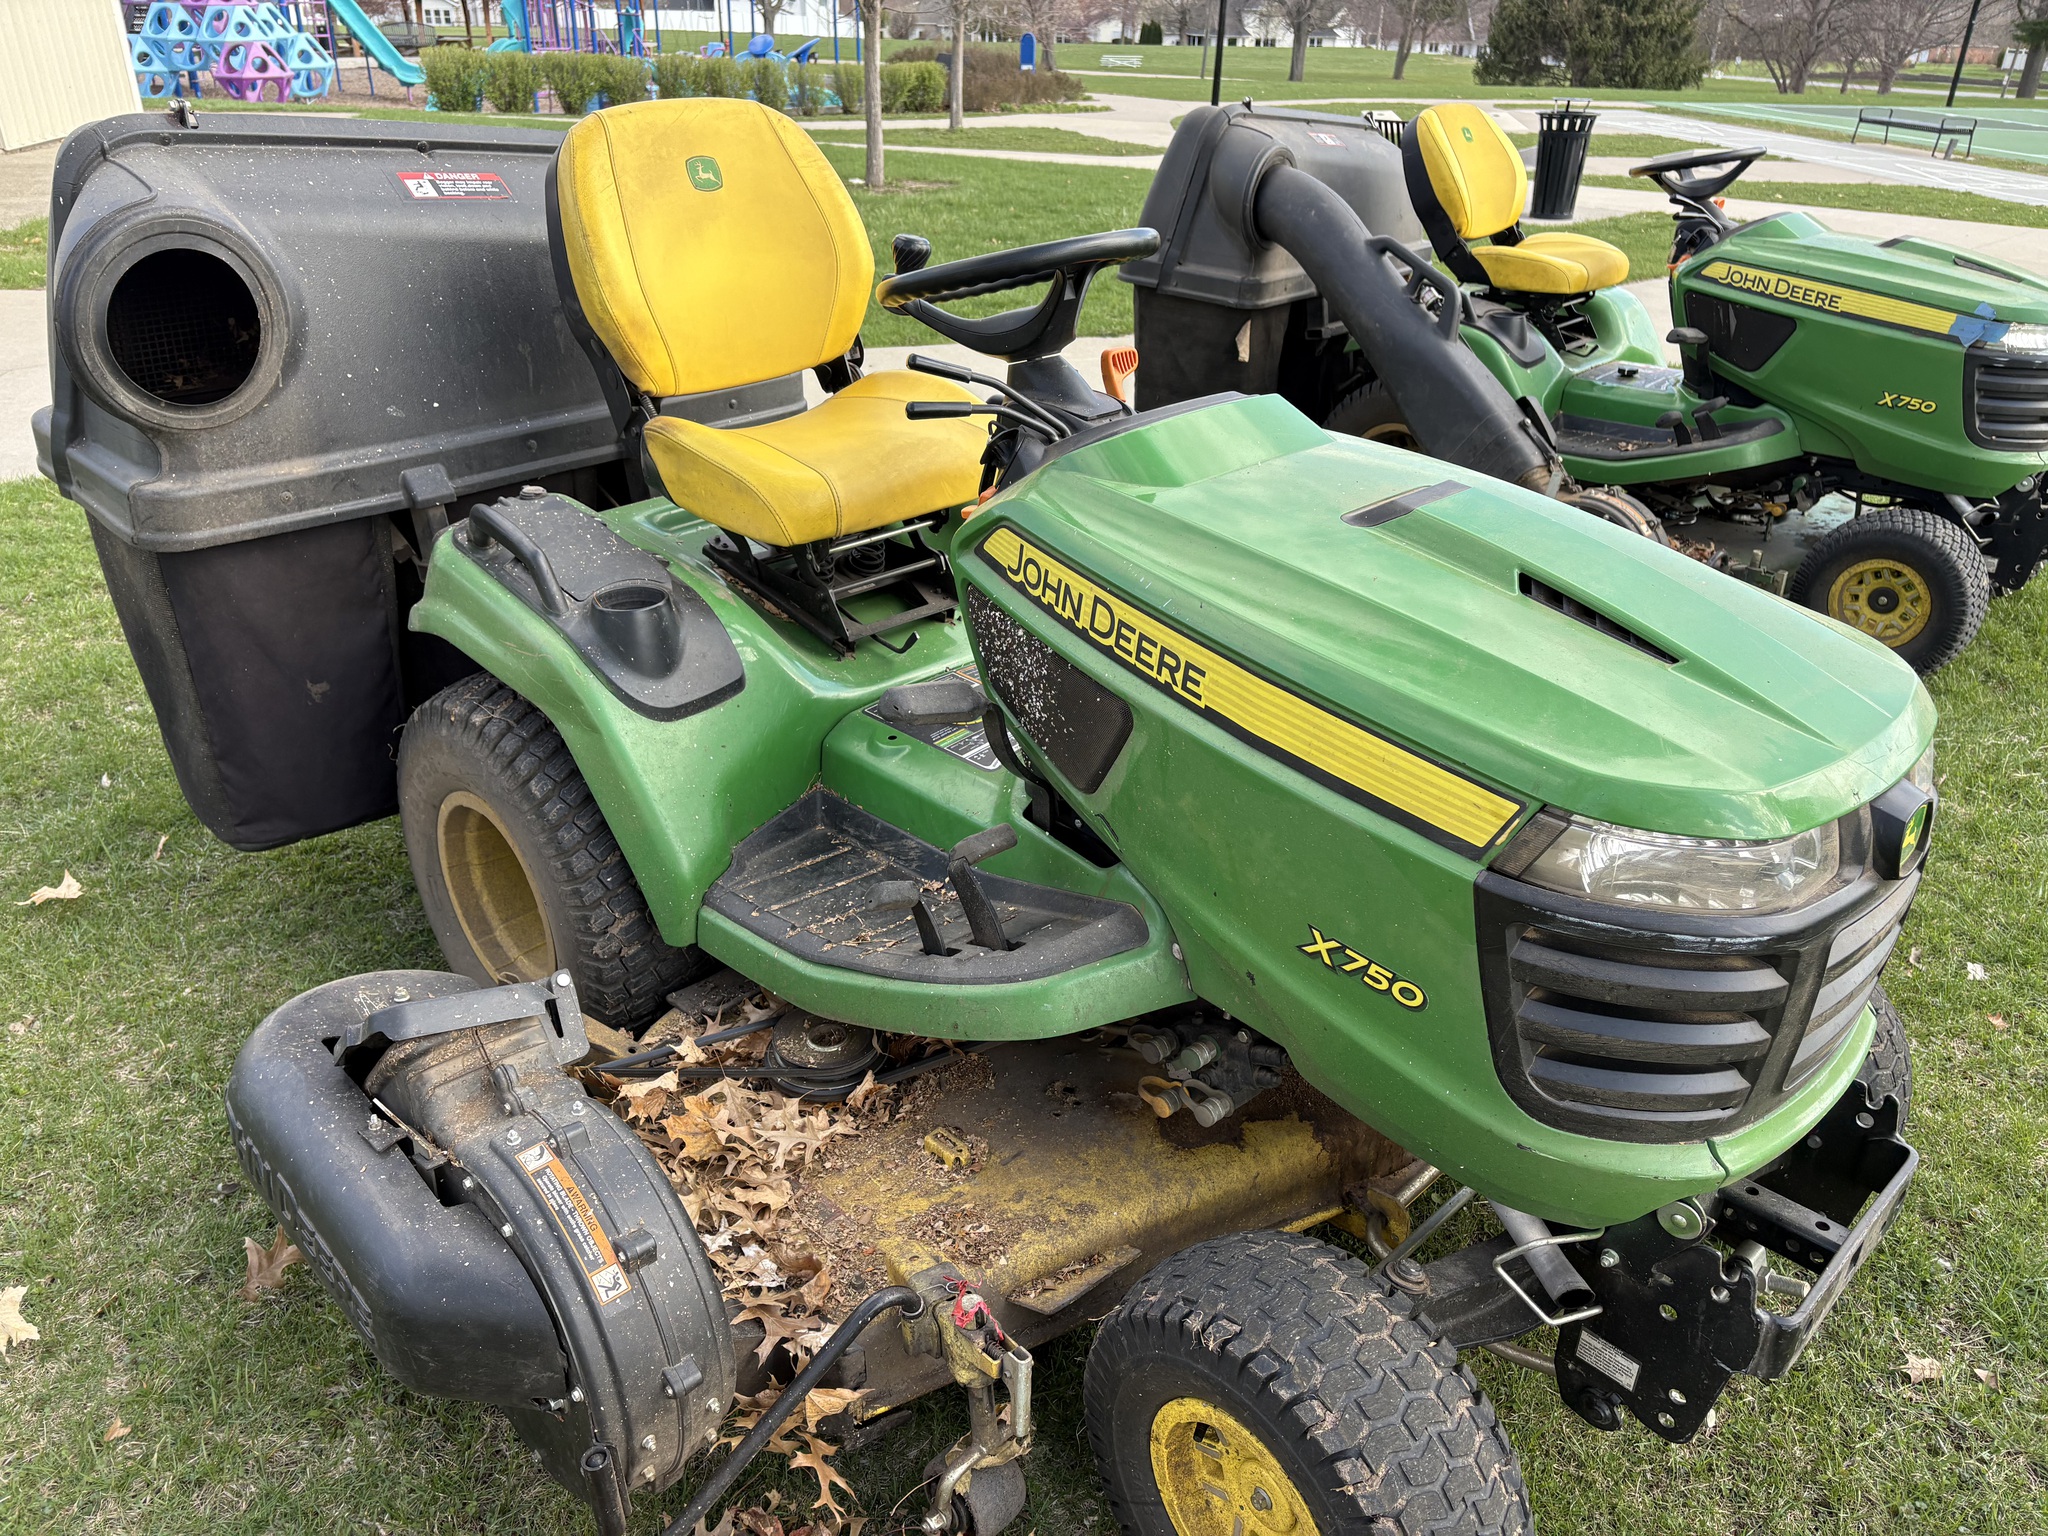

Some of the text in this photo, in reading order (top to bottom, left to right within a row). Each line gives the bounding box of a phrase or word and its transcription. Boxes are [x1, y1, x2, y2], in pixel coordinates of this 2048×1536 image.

[433, 172, 480, 180] DANGER
[1717, 265, 1842, 310] JOHN DEERE
[1876, 391, 1937, 414] X750
[1007, 544, 1206, 701] JOHN DEERE
[1296, 924, 1428, 1010] X750
[545, 1168, 563, 1191] ROTATING
[559, 1190, 574, 1209] BLADE
[572, 1210, 589, 1236] THROWN
[586, 1235, 604, 1264] OBJECTS
[552, 1190, 563, 1205] blower
[561, 1204, 569, 1216] with
[567, 1214, 577, 1228] entire
[573, 1228, 585, 1242] grass
[582, 1242, 595, 1261] catcher
[571, 1191, 598, 1232] WARNING
